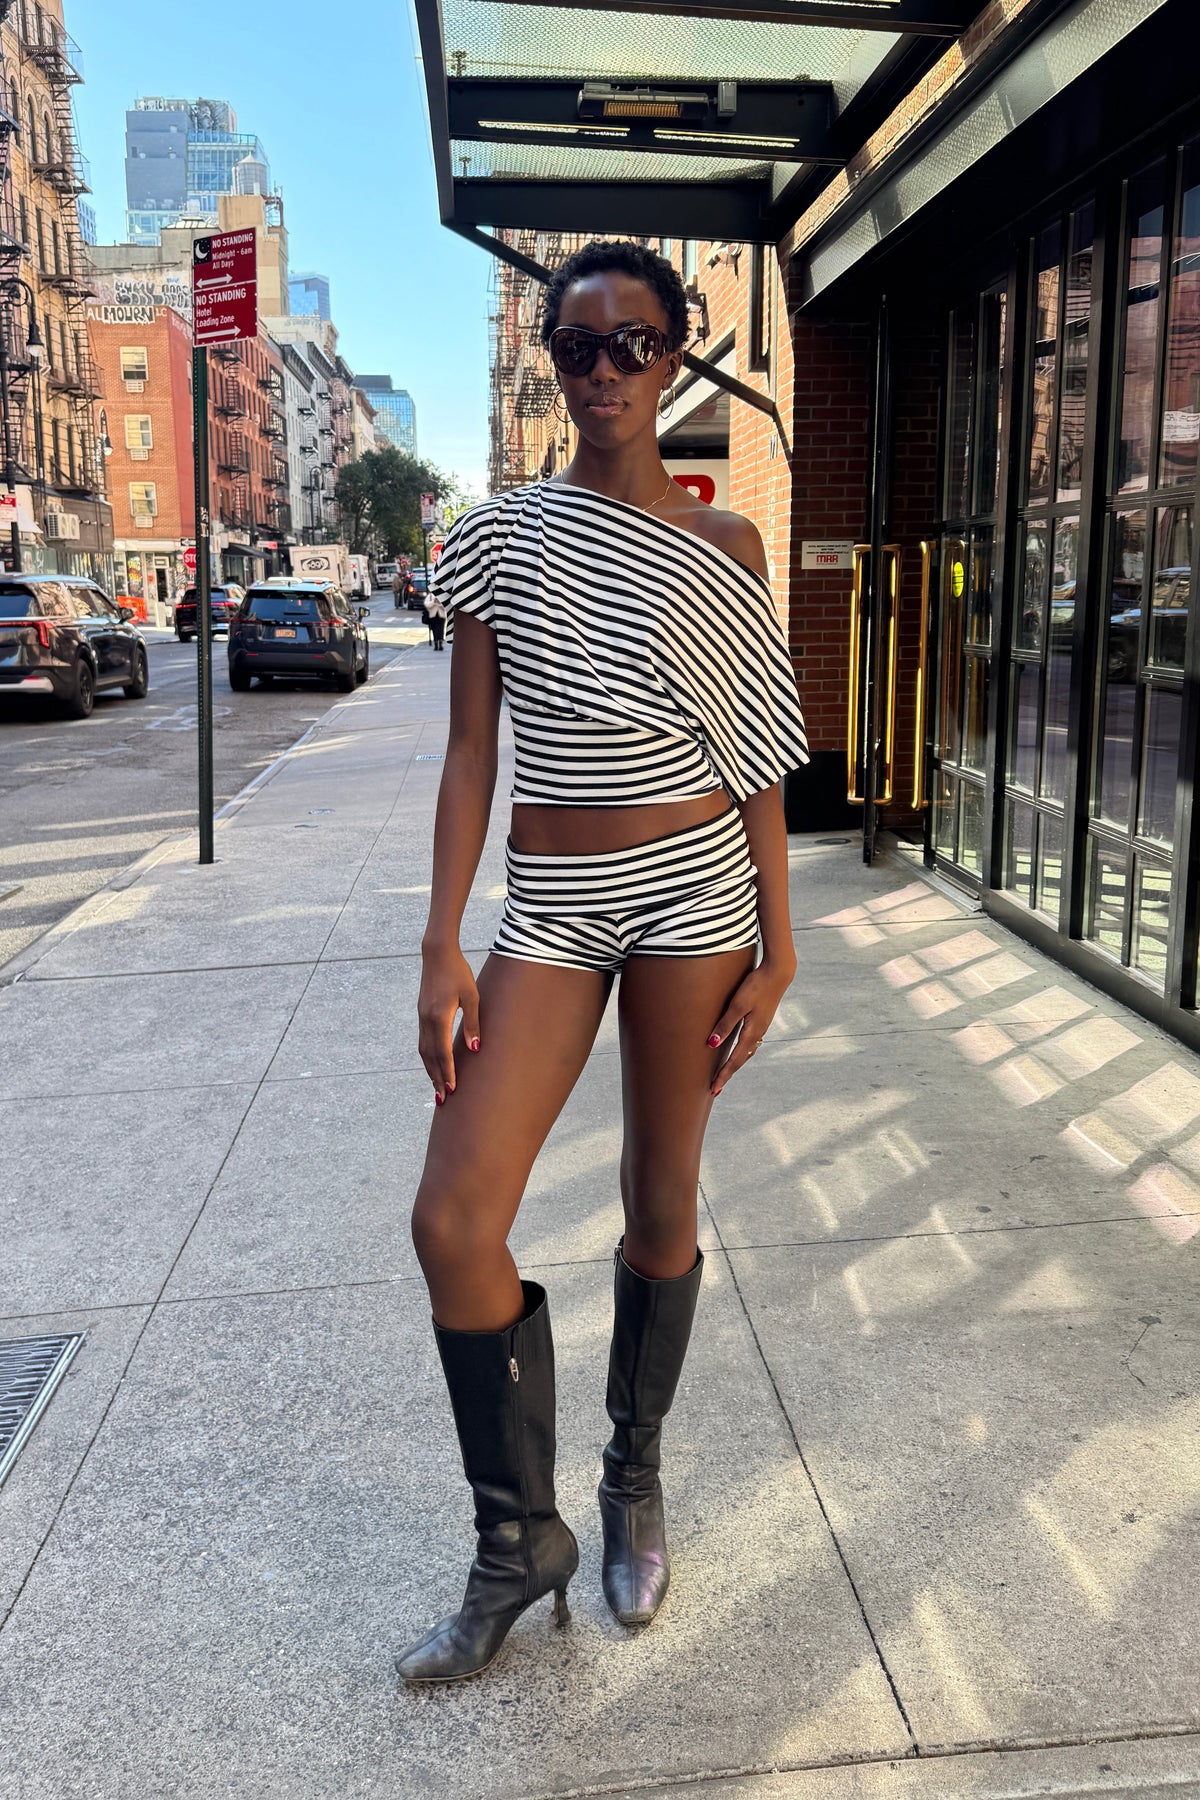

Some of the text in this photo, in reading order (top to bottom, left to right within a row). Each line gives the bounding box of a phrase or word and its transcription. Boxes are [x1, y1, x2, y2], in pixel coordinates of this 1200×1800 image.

[212, 233, 253, 249] NO STANDING
[212, 249, 236, 261] Midnight
[240, 247, 253, 256] 6am
[212, 260, 234, 270] All Days
[196, 295, 207, 306] NO
[208, 288, 247, 304] STANDING
[196, 307, 212, 318] Hotel
[196, 314, 235, 328] Loading Zone
